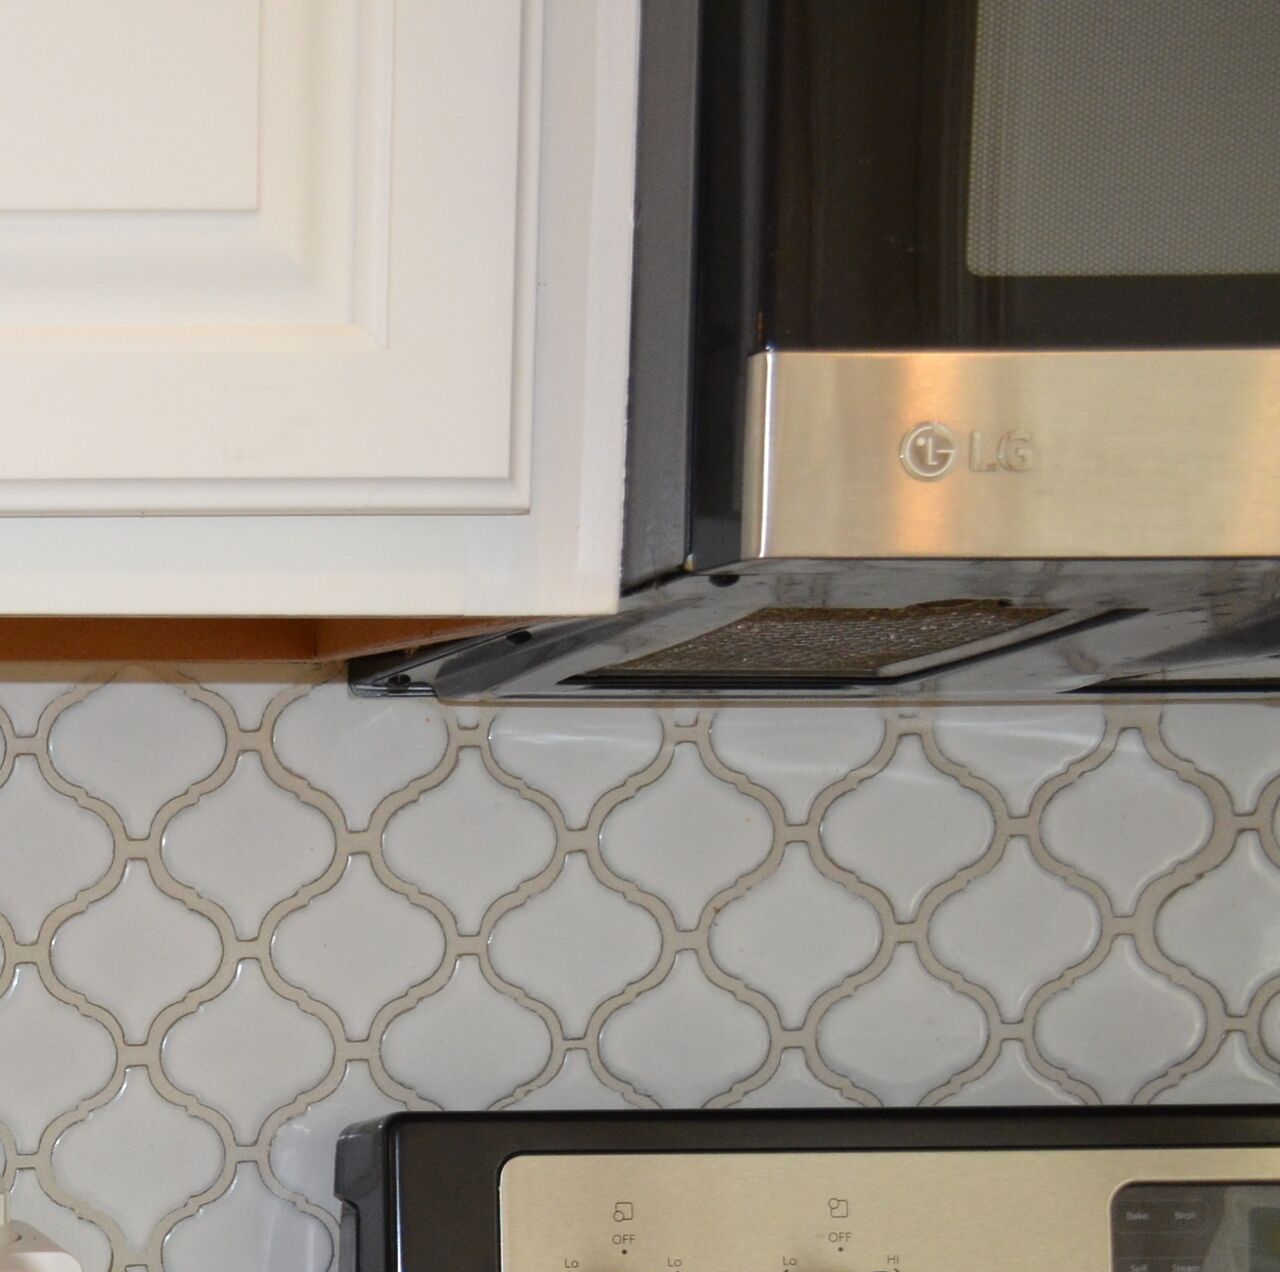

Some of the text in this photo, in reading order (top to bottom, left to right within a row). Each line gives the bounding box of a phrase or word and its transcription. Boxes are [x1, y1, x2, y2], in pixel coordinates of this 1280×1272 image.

[969, 430, 1034, 472] LG
[1126, 1211, 1150, 1220] Bake
[611, 1234, 636, 1246] OFF
[828, 1232, 852, 1243] OFF
[564, 1258, 579, 1269] Lo
[667, 1257, 682, 1268] Lo
[782, 1256, 797, 1266] Lo
[887, 1255, 899, 1265] Hi
[1172, 1264, 1200, 1272] Steam
